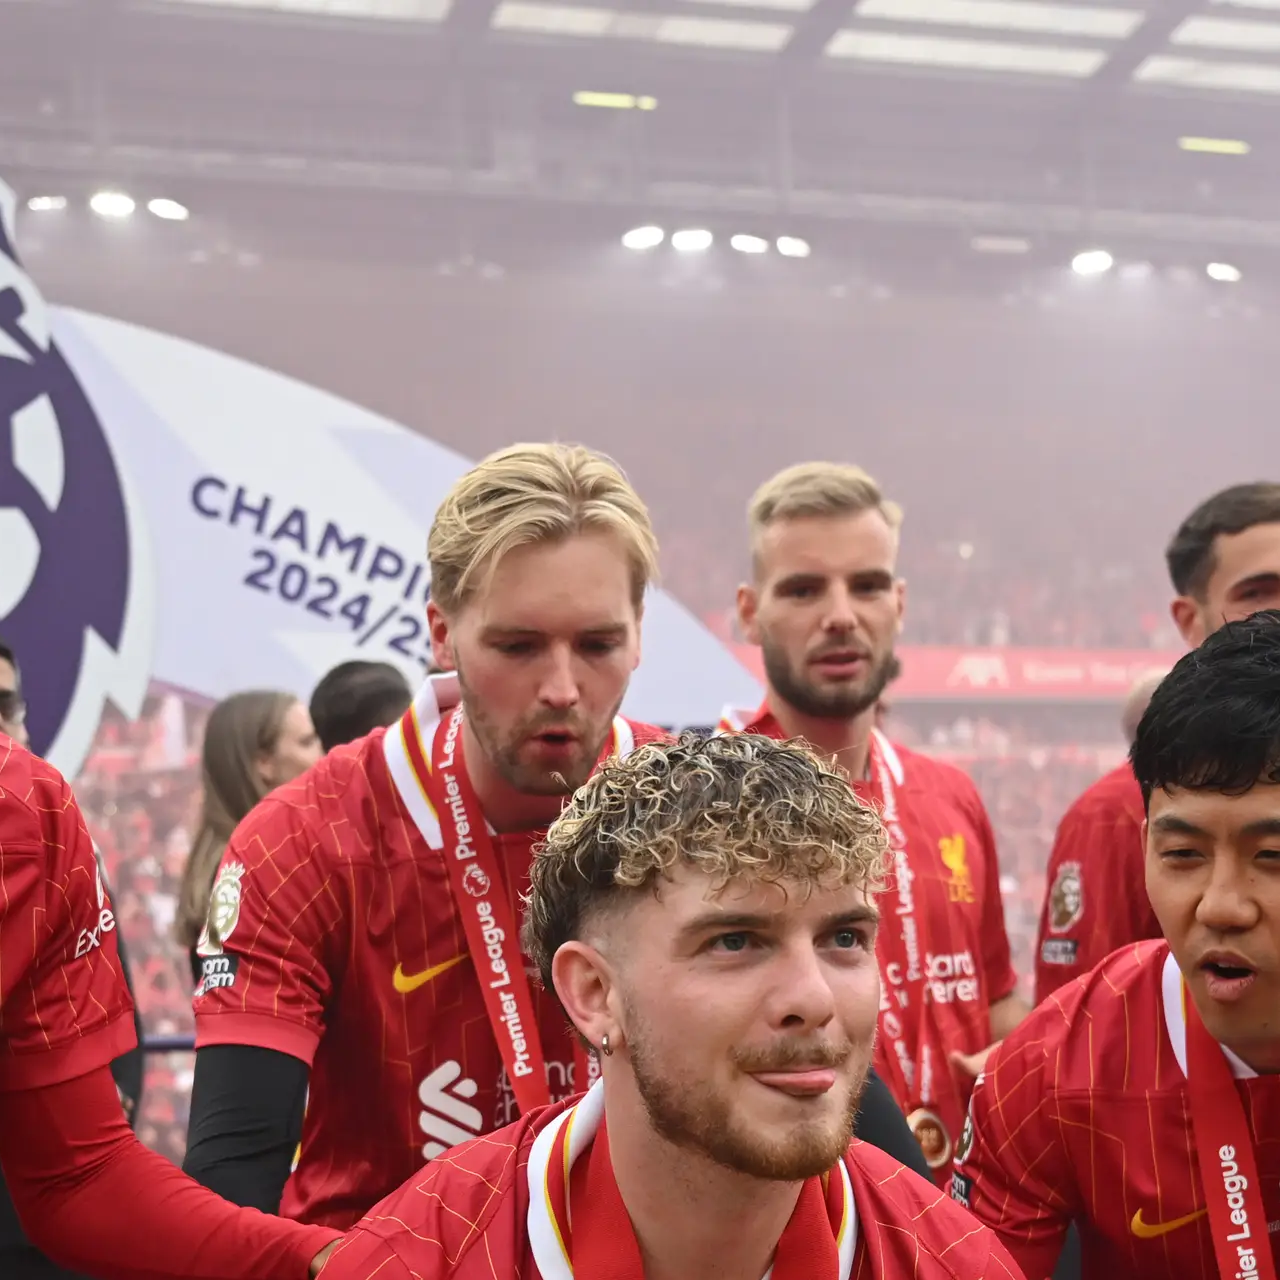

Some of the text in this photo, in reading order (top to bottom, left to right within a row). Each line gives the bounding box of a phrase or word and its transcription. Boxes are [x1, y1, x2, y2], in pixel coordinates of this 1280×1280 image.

[190, 476, 431, 602] CHAMPI
[437, 774, 477, 860] Premier
[475, 900, 534, 1078] Premier League
[1218, 1144, 1251, 1242] League
